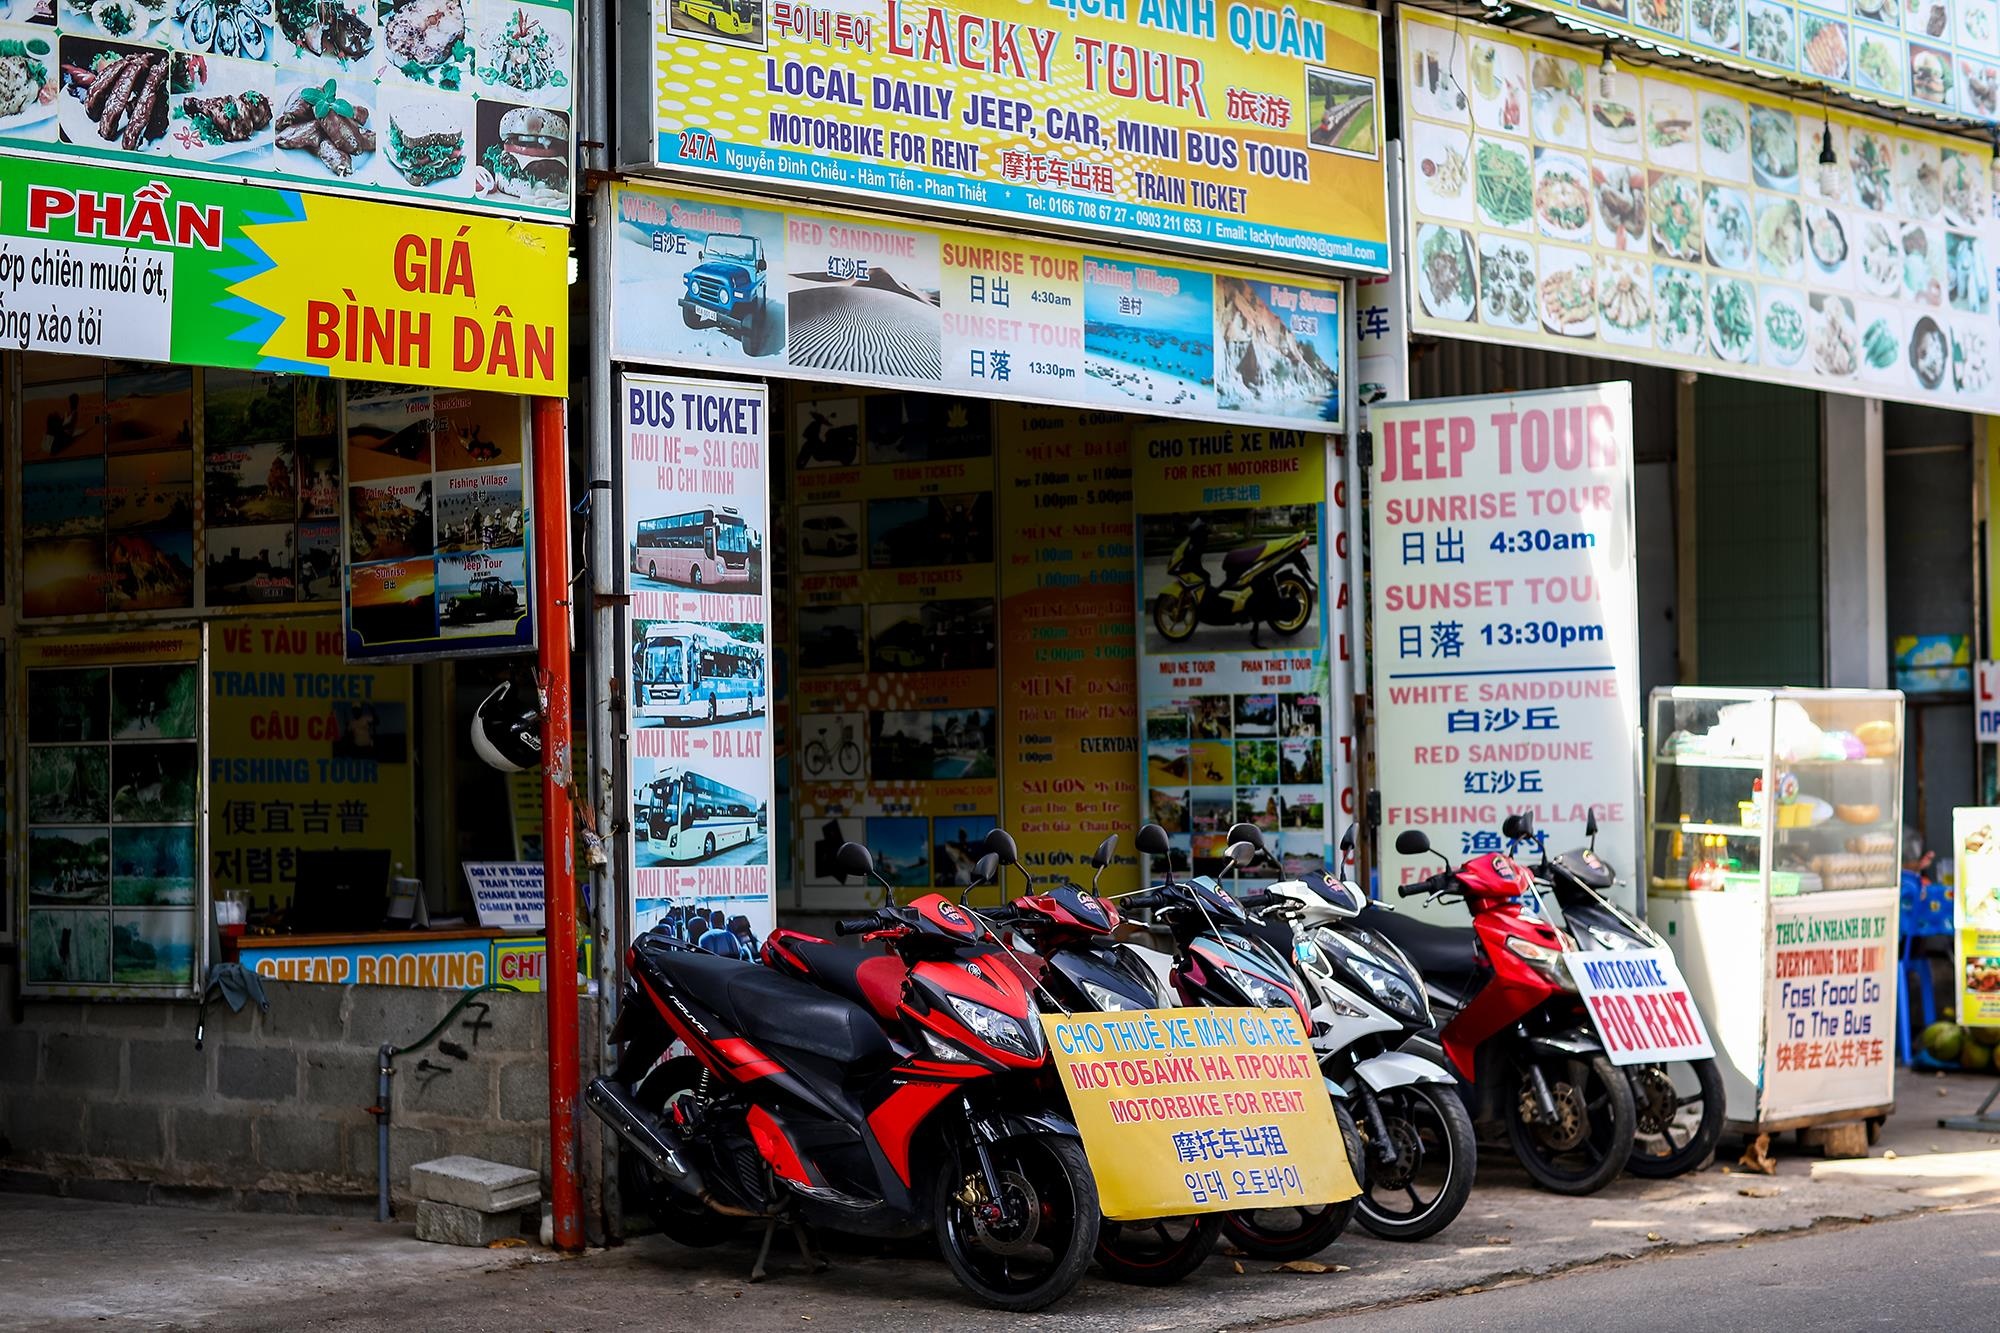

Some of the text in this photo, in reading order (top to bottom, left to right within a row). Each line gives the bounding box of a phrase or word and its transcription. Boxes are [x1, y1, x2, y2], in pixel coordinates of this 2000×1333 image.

[835, 14, 872, 53] 투어
[1229, 6, 1326, 61] QUÂN
[887, 0, 1206, 118] LACKY TOUR
[766, 58, 1310, 182] LOCAL DAILY JEEP, CAR, MINI BUS TOUR
[1226, 88, 1291, 128] 旅游
[769, 112, 979, 172] MOTORBIKE FOR RENT
[679, 131, 718, 162] 247A
[725, 148, 775, 172] Nguyễn
[858, 168, 885, 187] Hàm
[888, 171, 914, 192] Tiến
[925, 178, 955, 198] Phan
[957, 181, 987, 203] Thiết
[1001, 152, 1114, 193] 摩托车出租
[1136, 171, 1248, 215] TRAIN TICKET
[28, 182, 222, 250] PHẦN
[1026, 193, 1375, 260] Tel: 0166 708 67 27 0903 211 653 Email: lackytour0909@gmail.com
[652, 231, 688, 256] 白沙丘
[789, 221, 916, 259] RED SANDDUNE
[32, 248, 137, 293] chiên muối
[394, 225, 476, 297] GIÁ
[828, 255, 870, 282] 红沙丘
[943, 243, 1080, 282] SUNRISE TOUR
[1085, 261, 1131, 291] Fishing
[969, 274, 1010, 308] 日出
[1031, 290, 1072, 307] 4:30am
[1118, 296, 1143, 316] 渔村
[36, 304, 102, 345] xào tỏi
[306, 288, 555, 381] BÌNH DÂN
[942, 313, 1081, 350] SUNSET TOUR
[970, 349, 1012, 382] 日落
[1028, 361, 1076, 380] 13:30pm
[405, 403, 429, 414] Yellow
[630, 388, 761, 435] BUS TICKET
[632, 433, 759, 469] MUI NE SAI GON
[1149, 439, 1183, 458] CHO
[1188, 430, 1233, 455] THUÊ
[1241, 433, 1262, 452] XE
[1381, 405, 1617, 483] JEEP TOUR
[450, 474, 508, 489] Fishing Village
[657, 466, 734, 495] HO CHI MINH
[1164, 458, 1299, 481] FOR RENT MOTORBIKE
[388, 485, 416, 496] Stream
[1386, 486, 1612, 525] SUNRISE TOUR
[1402, 527, 1465, 565] 日出
[1490, 529, 1595, 553] 4:30am
[376, 568, 405, 578] Sunrise
[464, 558, 503, 571] Jeep Tour
[633, 591, 762, 623] MUI NE VUNG TAU
[1385, 580, 1513, 612] SUNSET
[1400, 620, 1464, 658] 日落
[1480, 622, 1604, 648] 13:30pm
[1160, 660, 1216, 674] MUI NE TOUR
[1241, 659, 1312, 672] PHAN THIET TOUR
[213, 671, 375, 698] TRAIN TICKET
[1389, 679, 1617, 704] WHITE SANDDUNE
[251, 711, 299, 740] CÂU
[1448, 707, 1560, 733] 白沙丘
[636, 729, 763, 758] MUI NE DA LAT
[1081, 736, 1138, 753] EVERYDAY
[1414, 742, 1592, 764] RED SANDDUNE
[211, 758, 378, 783] FISHING TOUR
[1464, 770, 1543, 794] 红沙丘
[222, 799, 368, 835] 便宜吉普
[1388, 806, 1497, 825] FISHING
[478, 891, 517, 899] CHANGE
[479, 879, 542, 888] TRAIN TICKET
[637, 867, 767, 897] MUI NE PHAN RANG
[1823, 917, 1859, 941] NHANH
[358, 952, 485, 988] BOOKING
[1584, 959, 1667, 991] MOTOBIKE
[1776, 948, 1859, 979] EVERYTHING TAKE
[1782, 977, 1880, 1009] Fast Food Go
[1056, 1010, 1237, 1054] CHO THUÊ XE MÁY
[1590, 991, 1702, 1051] FOR RENT
[1788, 1009, 1871, 1039] To The Bus
[1070, 1053, 1312, 1090] МОТОБАЙК НА ПРОКАТ
[1109, 1091, 1306, 1124] MOTORBIKE FOR RENT
[1172, 1126, 1288, 1163] 摩托车出租
[1185, 1166, 1304, 1203] 임대 오토바이
